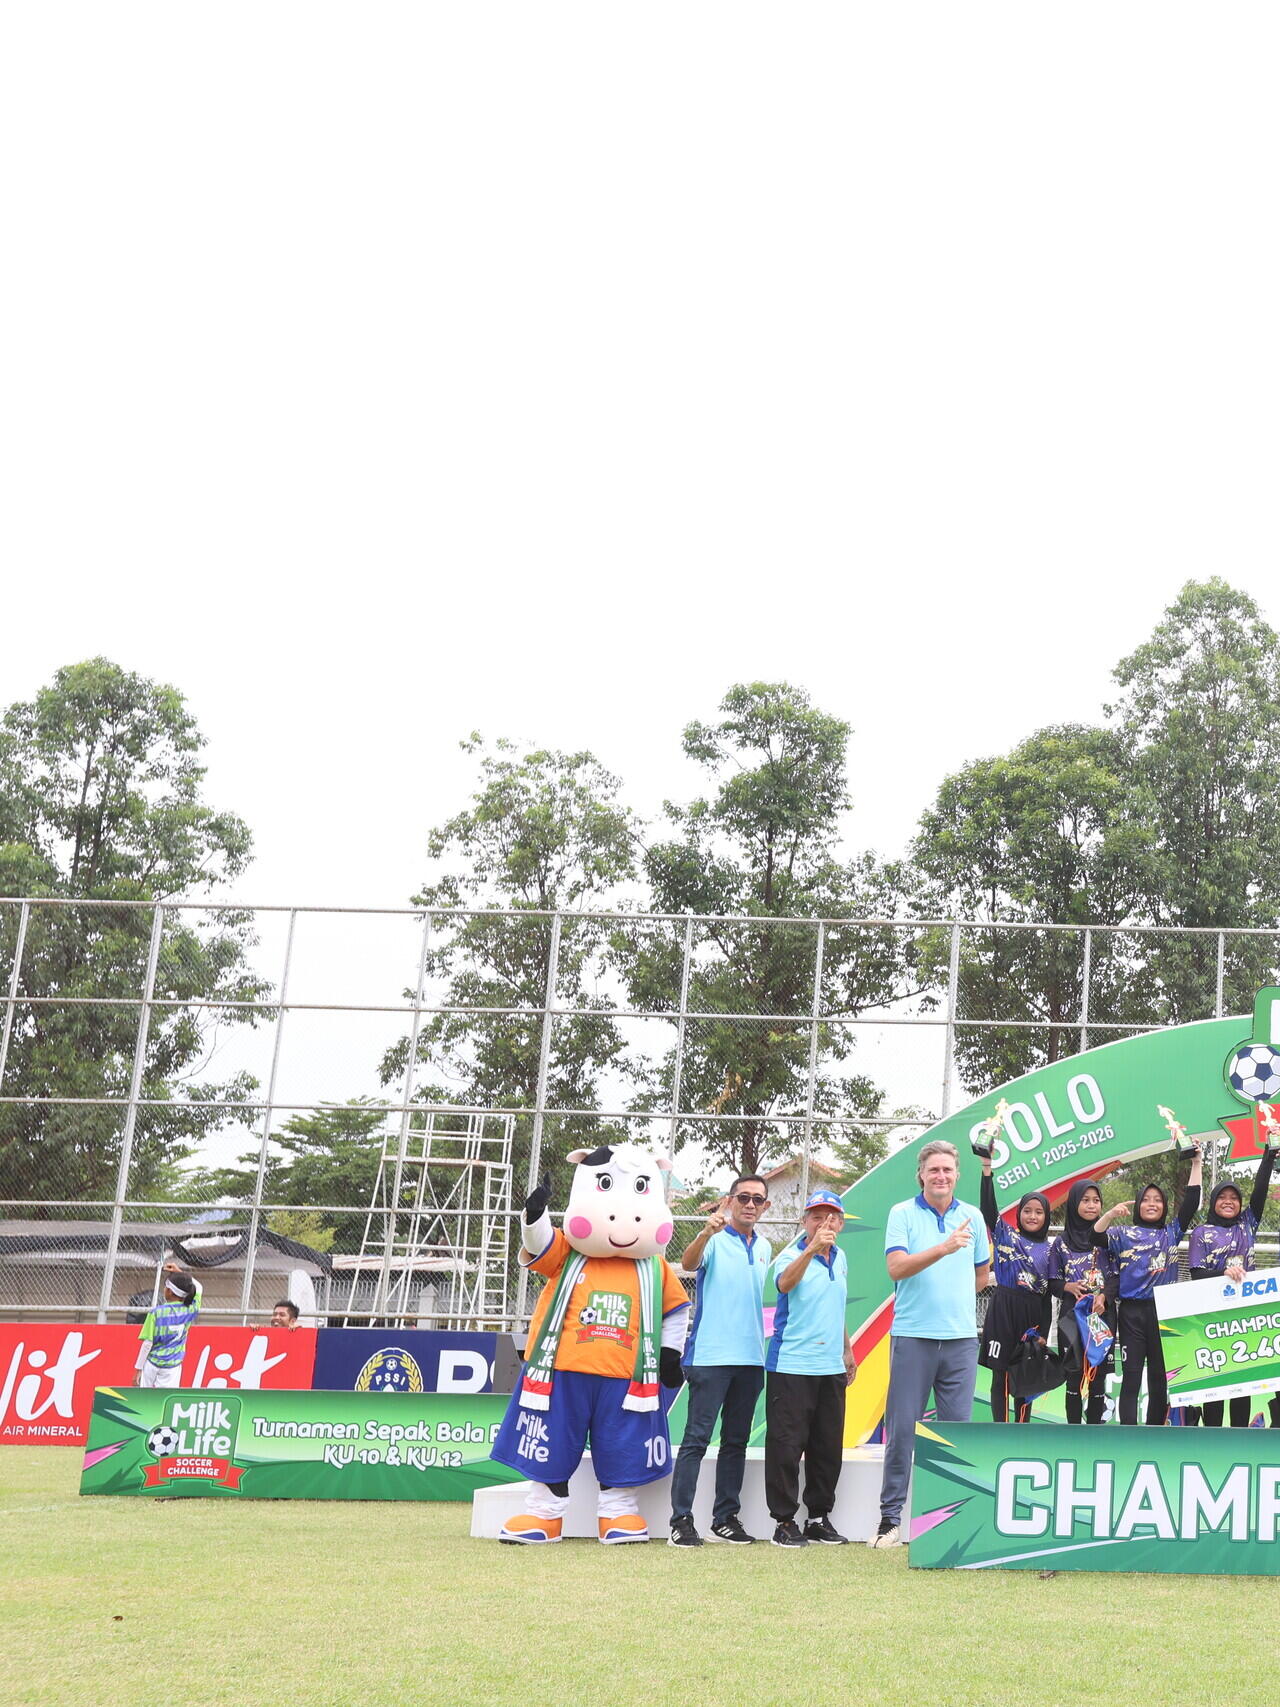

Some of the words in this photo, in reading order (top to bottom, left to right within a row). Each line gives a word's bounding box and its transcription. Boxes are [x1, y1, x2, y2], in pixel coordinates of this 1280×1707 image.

[996, 1161, 1031, 1190] SERI
[1031, 1157, 1041, 1171] 1
[1043, 1124, 1115, 1166] 2025-2026
[1241, 1277, 1279, 1298] BCA
[592, 1293, 628, 1313] Milk
[596, 1308, 628, 1328] Life
[988, 1340, 1002, 1359] 10
[1195, 1348, 1227, 1372] Rp
[374, 1372, 407, 1387] PSSI
[171, 1401, 232, 1431] Milk
[515, 1410, 550, 1443] Milk
[3, 1426, 24, 1436] AIR
[27, 1425, 83, 1437] MINERAL
[177, 1429, 232, 1456] Life
[252, 1417, 360, 1441] Turnamen
[363, 1420, 430, 1446] Sepak
[436, 1422, 486, 1443] Bola
[323, 1443, 355, 1470] KU
[359, 1448, 380, 1466] 10
[385, 1446, 401, 1467] &
[406, 1445, 437, 1472] KU
[440, 1450, 463, 1468] 12
[516, 1436, 549, 1463] Life
[644, 1435, 666, 1468] 10
[166, 1465, 220, 1477] CHALLENGE
[175, 1457, 213, 1468] SOCCER
